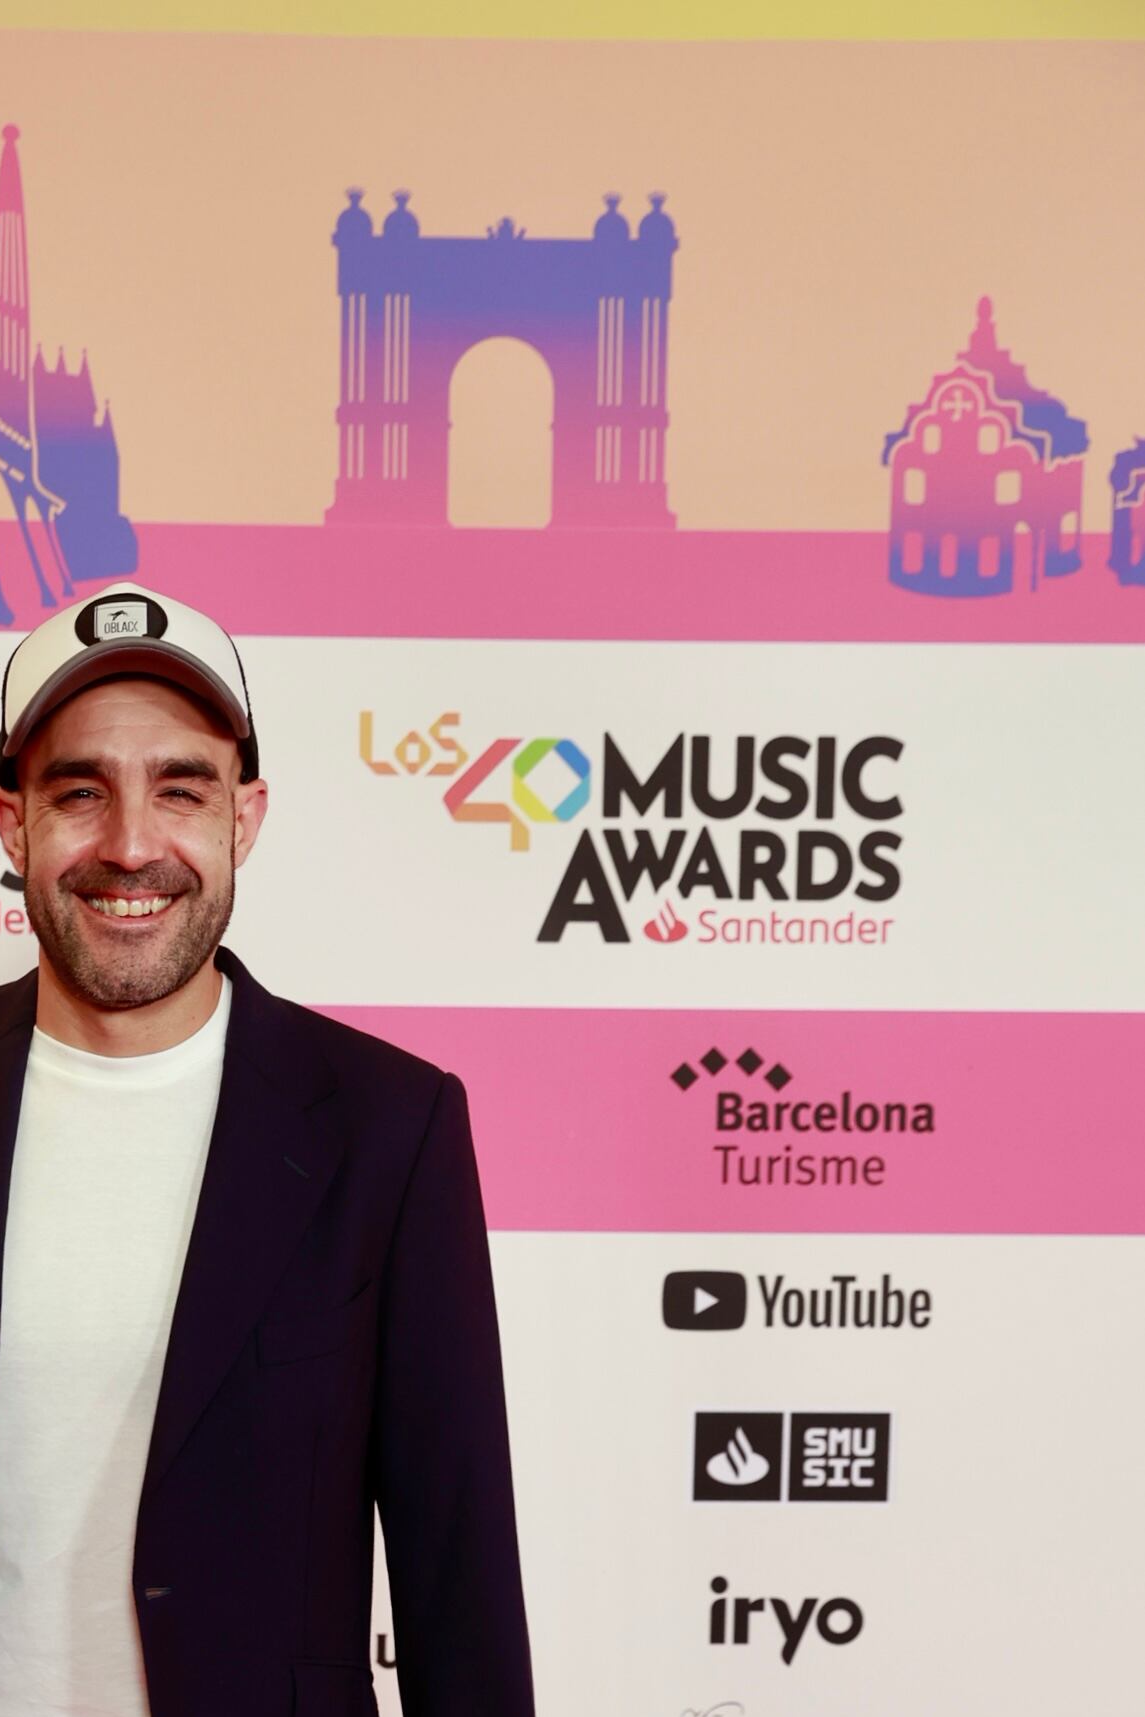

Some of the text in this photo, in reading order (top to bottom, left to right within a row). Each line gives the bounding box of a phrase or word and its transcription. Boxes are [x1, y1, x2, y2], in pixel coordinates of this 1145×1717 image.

[602, 730, 905, 821] MUSIC
[535, 825, 903, 943] AWARDS
[696, 908, 896, 946] Santander
[716, 1091, 936, 1134] Barcelona
[713, 1144, 886, 1187] Turisme
[757, 1273, 932, 1329] YouTube
[709, 1575, 864, 1666] iryo
